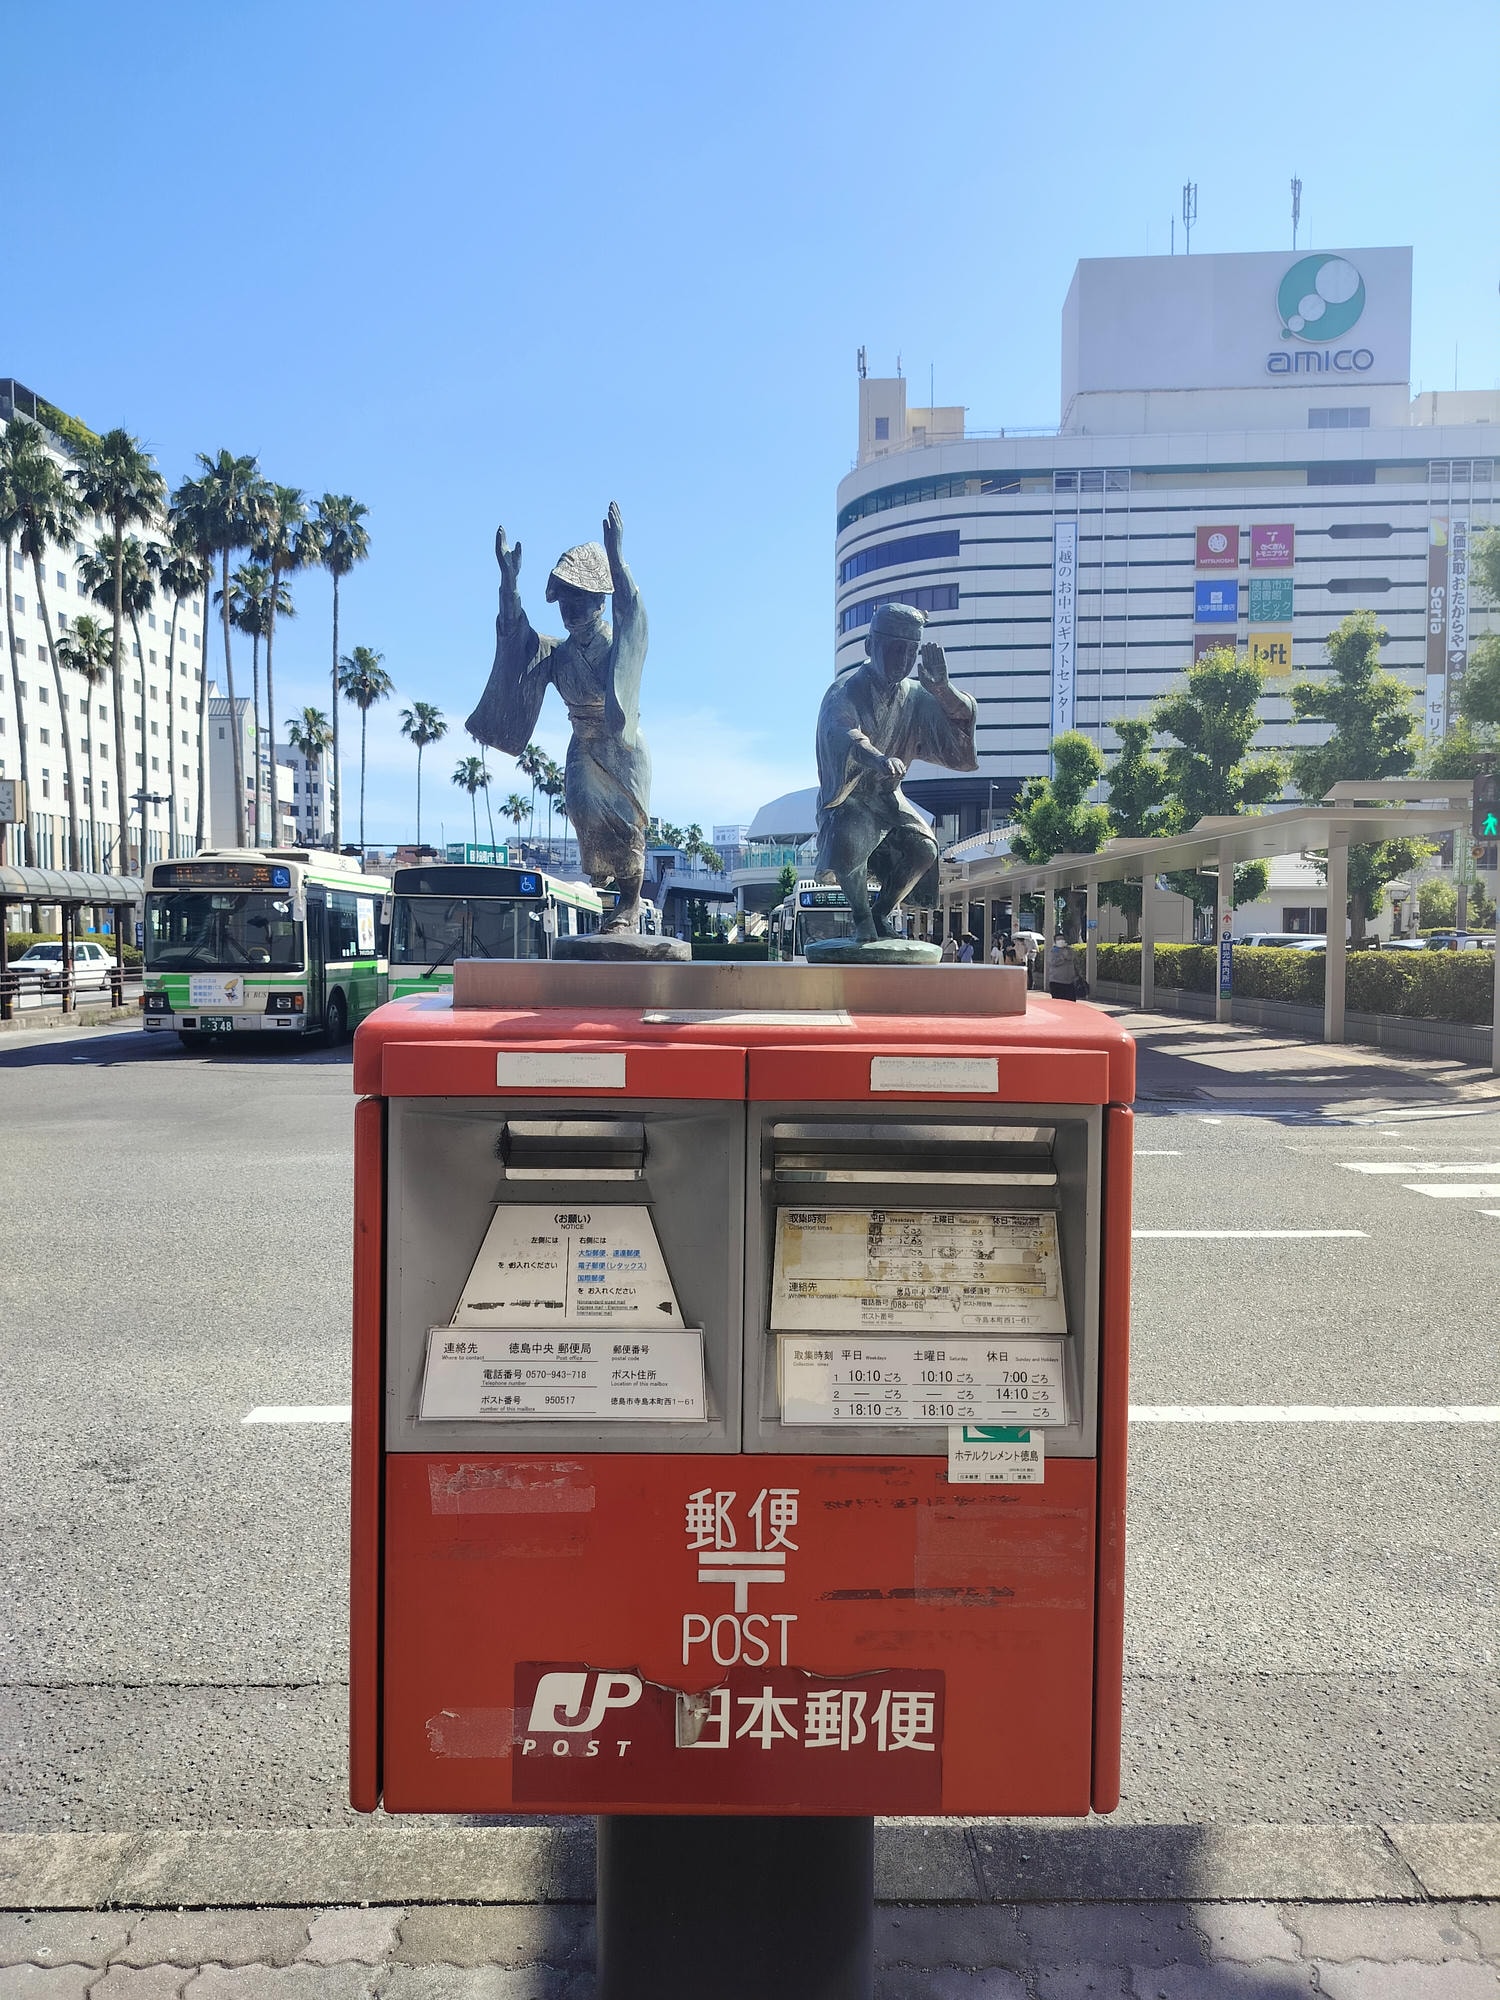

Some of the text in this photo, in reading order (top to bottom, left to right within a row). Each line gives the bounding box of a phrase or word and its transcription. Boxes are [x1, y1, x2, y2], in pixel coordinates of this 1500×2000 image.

[1266, 348, 1375, 375] amico
[1430, 586, 1445, 634] Seria
[1057, 535, 1072, 724] 三越のお中元ギフトセンター
[932, 1215, 954, 1224] 土曜日
[531, 1236, 559, 1244] 左側には
[588, 1286, 637, 1295] お入れください
[789, 1282, 818, 1292] 連絡先
[443, 1342, 591, 1354] 連絡先 徳島中央 郵便局
[613, 1345, 650, 1355] 郵便番号
[794, 1350, 833, 1361] 取集時刻
[841, 1350, 862, 1361] 平日
[913, 1350, 946, 1361] 土曜日
[987, 1351, 1009, 1362] 休日
[483, 1369, 587, 1379] 電話番号 0570-943-718
[611, 1370, 657, 1380] ポスト住所
[848, 1370, 881, 1382] 10:10
[884, 1374, 901, 1383] ごろ
[921, 1370, 974, 1383] 10:10 ごろ
[1003, 1371, 1048, 1384] 7:00 ごろ
[834, 1390, 902, 1399] 2 ごろ
[957, 1391, 974, 1400] ごろ
[996, 1388, 1049, 1400] 14:10 ごろ
[481, 1396, 575, 1405] ポスト番号 950517
[849, 1404, 881, 1416] 18:10
[885, 1407, 902, 1416] ごろ
[922, 1404, 975, 1417] 18:10 ごろ
[1032, 1408, 1050, 1417] ごろ
[955, 1449, 1039, 1463] ホテルクレメント徳島
[684, 1487, 800, 1551] 郵便
[682, 1613, 798, 1667] POST
[521, 1739, 633, 1757] POST
